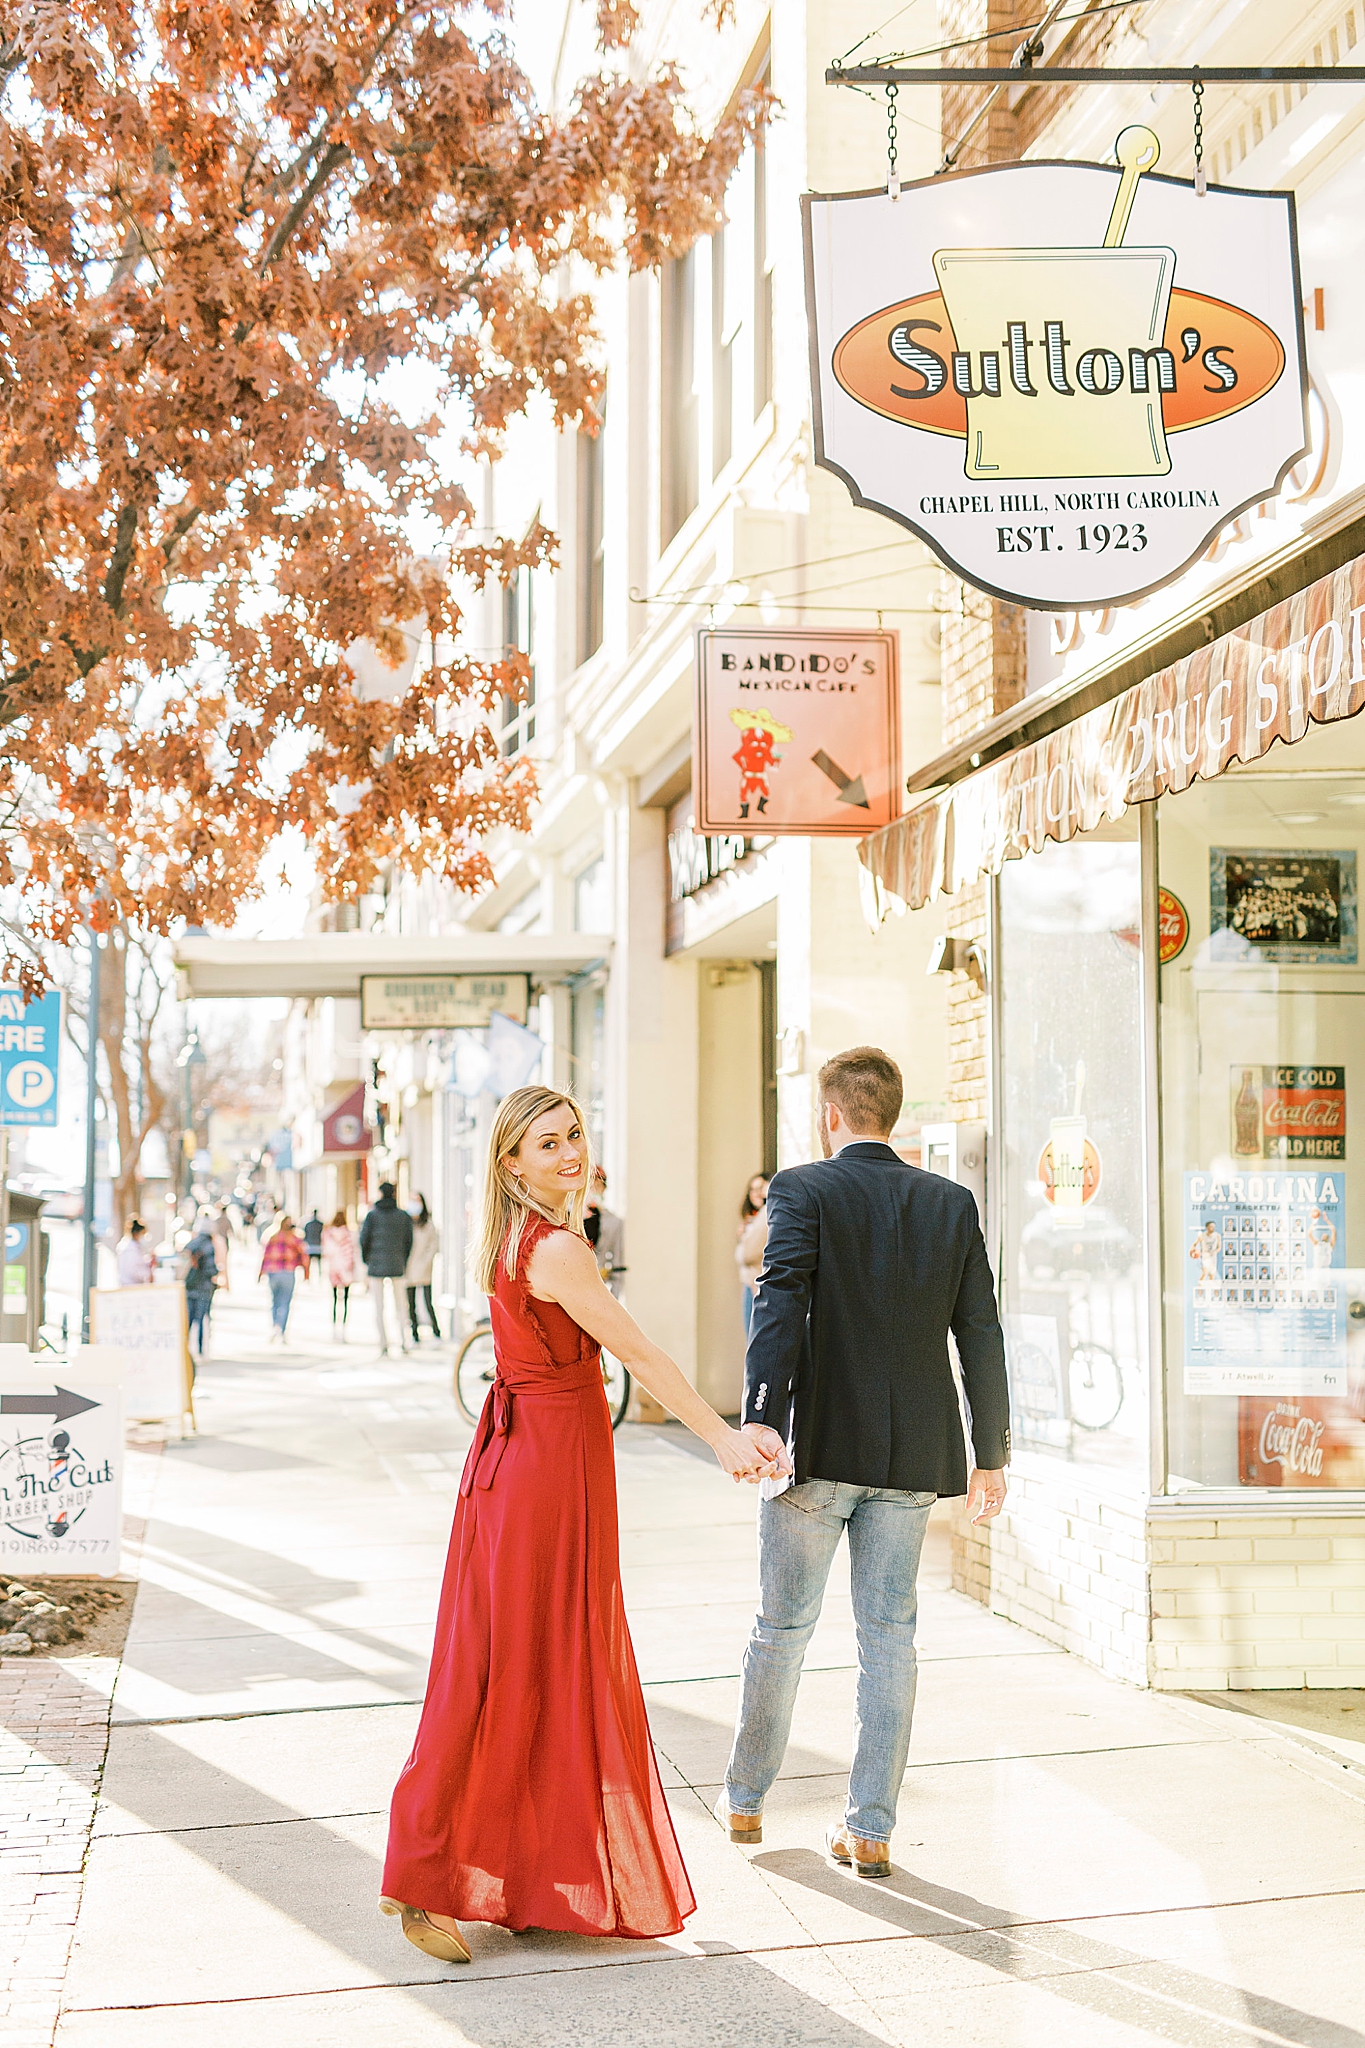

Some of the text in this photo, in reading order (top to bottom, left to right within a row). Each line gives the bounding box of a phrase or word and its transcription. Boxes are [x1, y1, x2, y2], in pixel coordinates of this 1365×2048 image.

[887, 318, 1239, 399] Sutton's
[919, 489, 1221, 515] CHAPEL HILL, NORTH CAROLINA
[995, 523, 1148, 554] EST. 1923
[721, 652, 877, 675] BANDIDO'S
[739, 678, 858, 692] MEXICAN CAFE
[1129, 679, 1234, 781] DRUG
[1254, 603, 1365, 729] STOR
[0, 994, 27, 1021] AY
[1272, 1069, 1337, 1086] ICE COLD
[1265, 1098, 1342, 1128] Coca-Cola
[1269, 1138, 1341, 1156] SLD HERE
[1189, 1175, 1340, 1203] CAROLINA
[1235, 1204, 1294, 1212] BASKETBAL
[16, 1473, 65, 1499] The
[0, 1489, 94, 1519] ARBER SHOP
